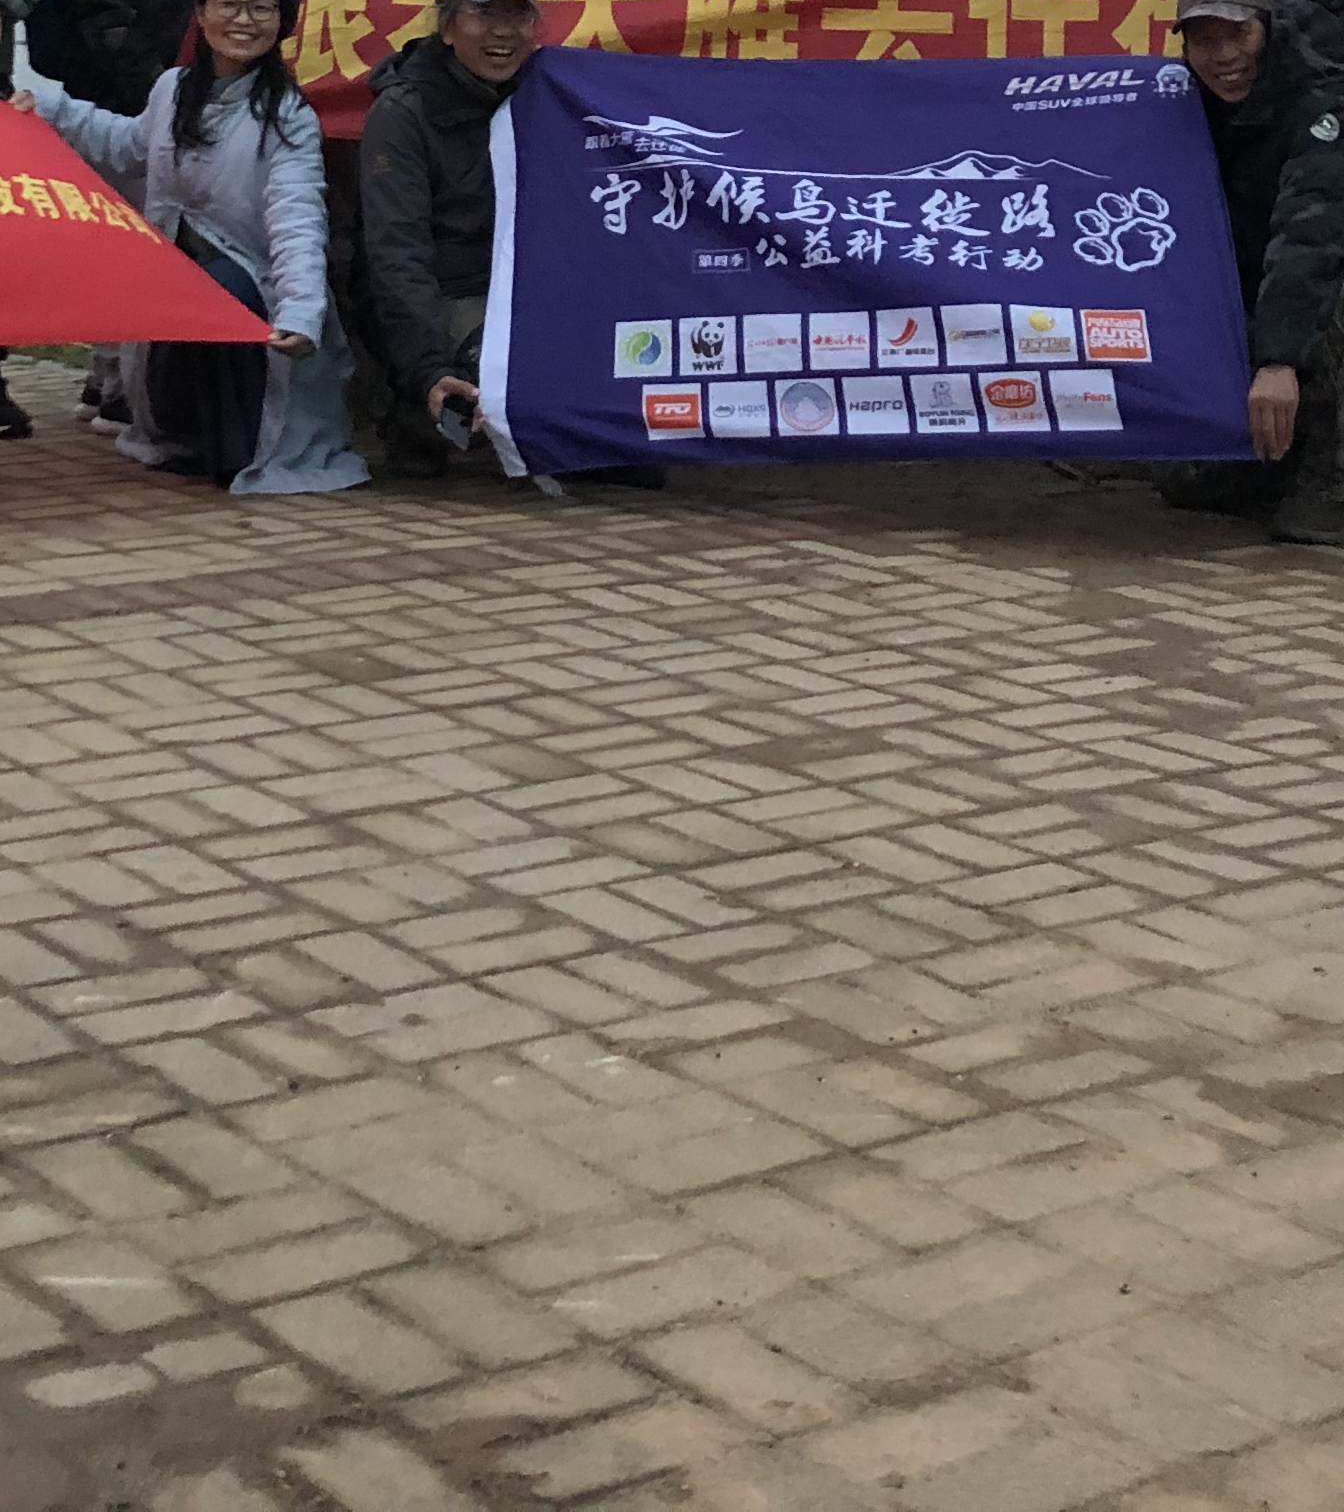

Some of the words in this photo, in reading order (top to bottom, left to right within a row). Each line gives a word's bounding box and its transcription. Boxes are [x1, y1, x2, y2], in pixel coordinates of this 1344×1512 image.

[1004, 69, 1145, 96] HAVAL
[590, 169, 1056, 238] 守护候鸟迁徙路
[756, 225, 1044, 272] 公益科考行动
[1089, 327, 1142, 339] AUTO
[692, 360, 725, 372] WWF
